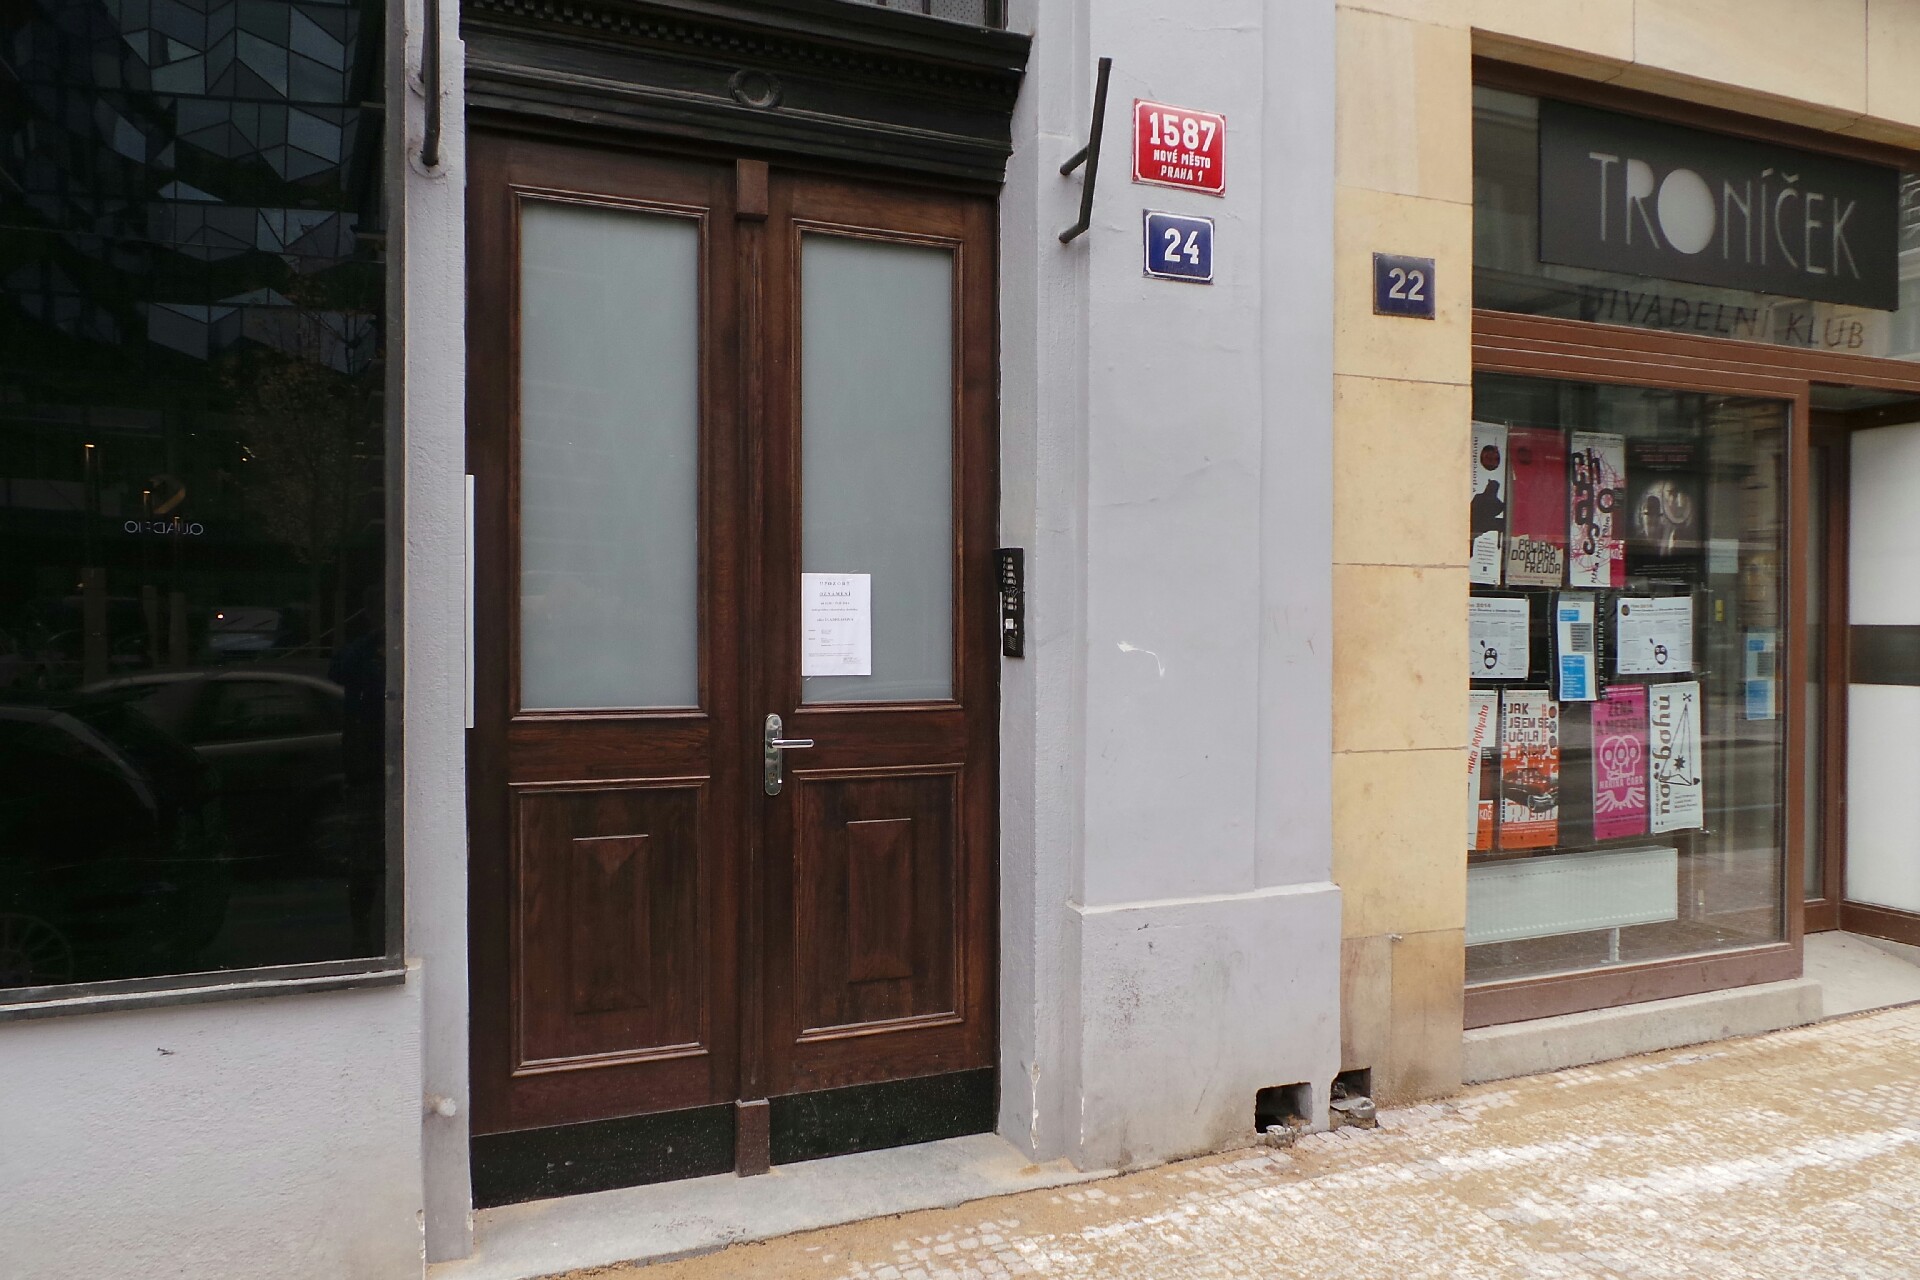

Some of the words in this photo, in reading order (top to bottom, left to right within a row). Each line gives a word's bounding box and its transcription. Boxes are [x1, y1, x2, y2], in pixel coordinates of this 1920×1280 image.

[1150, 112, 1216, 152] 1587
[1153, 149, 1178, 163] NOVÉ
[1181, 151, 1211, 169] MĚSTO
[1161, 166, 1193, 181] PRAHA
[1197, 170, 1203, 182] 1
[1589, 151, 1860, 279] TRONÍČEK
[1164, 228, 1199, 265] 24
[1389, 268, 1424, 301] 22
[1785, 312, 1864, 348] KLUB
[1511, 549, 1556, 563] DOKTORA
[1524, 562, 1561, 574] FREUDA
[1508, 703, 1529, 715] JAK
[1508, 717, 1536, 728] JSEM
[1538, 718, 1550, 728] SE
[1508, 729, 1539, 742] UČILA
